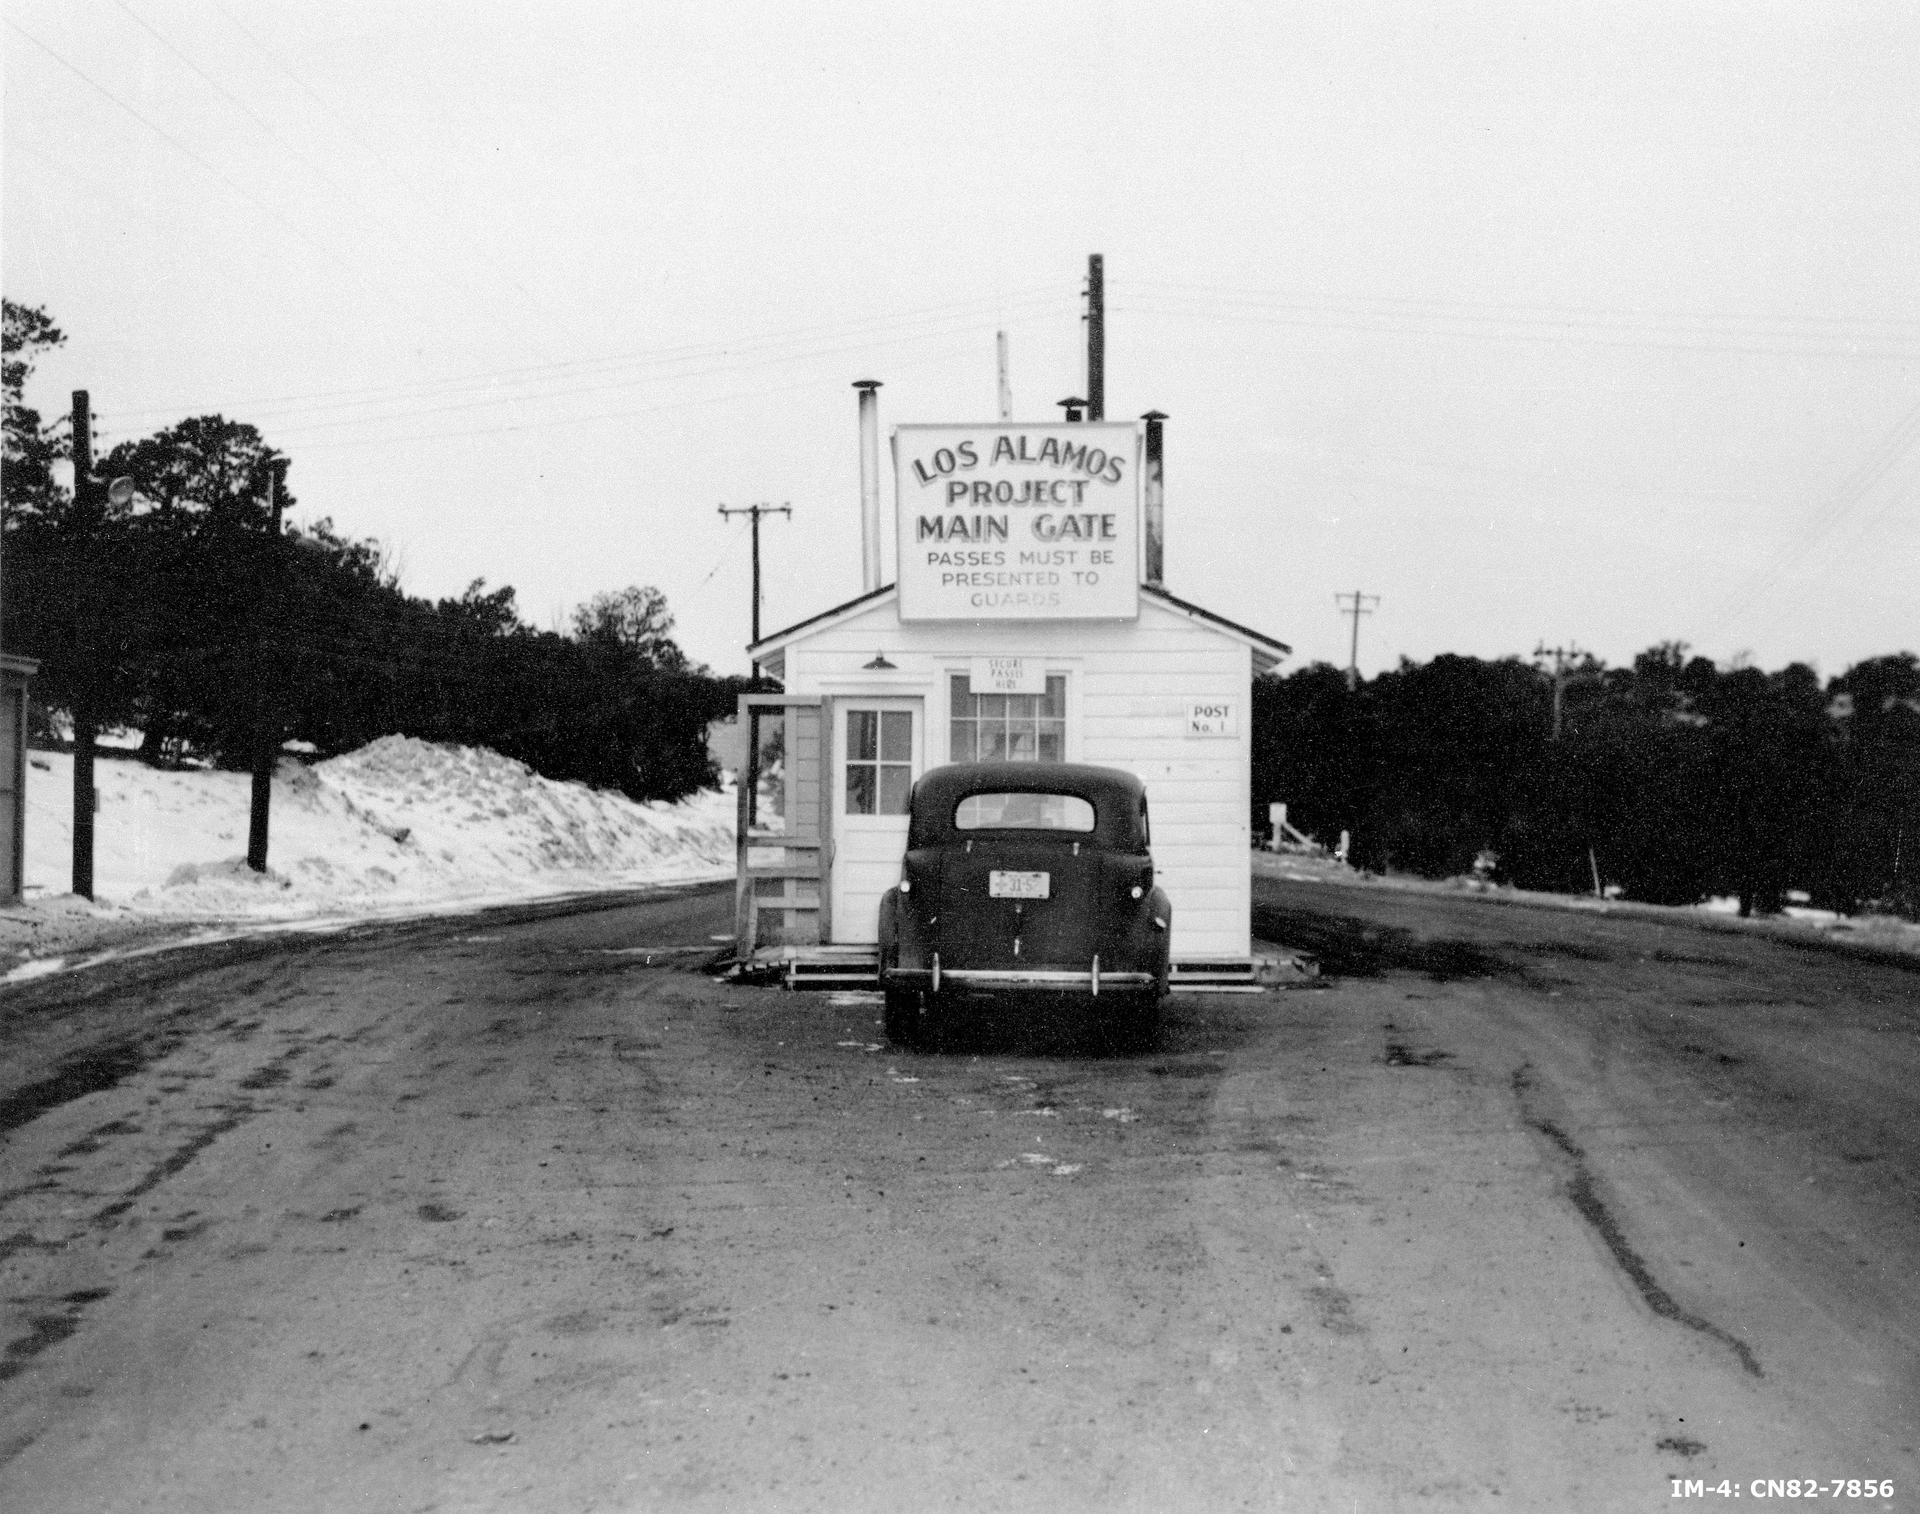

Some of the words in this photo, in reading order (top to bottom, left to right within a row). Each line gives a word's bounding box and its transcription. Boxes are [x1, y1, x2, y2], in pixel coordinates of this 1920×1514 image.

[911, 440, 979, 488] LOS
[989, 435, 1126, 486] ALAMOS
[946, 480, 1090, 508] PROJECT
[916, 514, 1009, 543] MAIN
[1031, 513, 1117, 542] GATE
[927, 551, 1006, 566] PASSES
[1019, 550, 1078, 565] MUST
[1090, 549, 1115, 565] BE
[941, 571, 1060, 586] PRESENTED
[1072, 571, 1099, 586] TO
[970, 592, 1061, 607] GUARDS
[1194, 706, 1228, 718] POST
